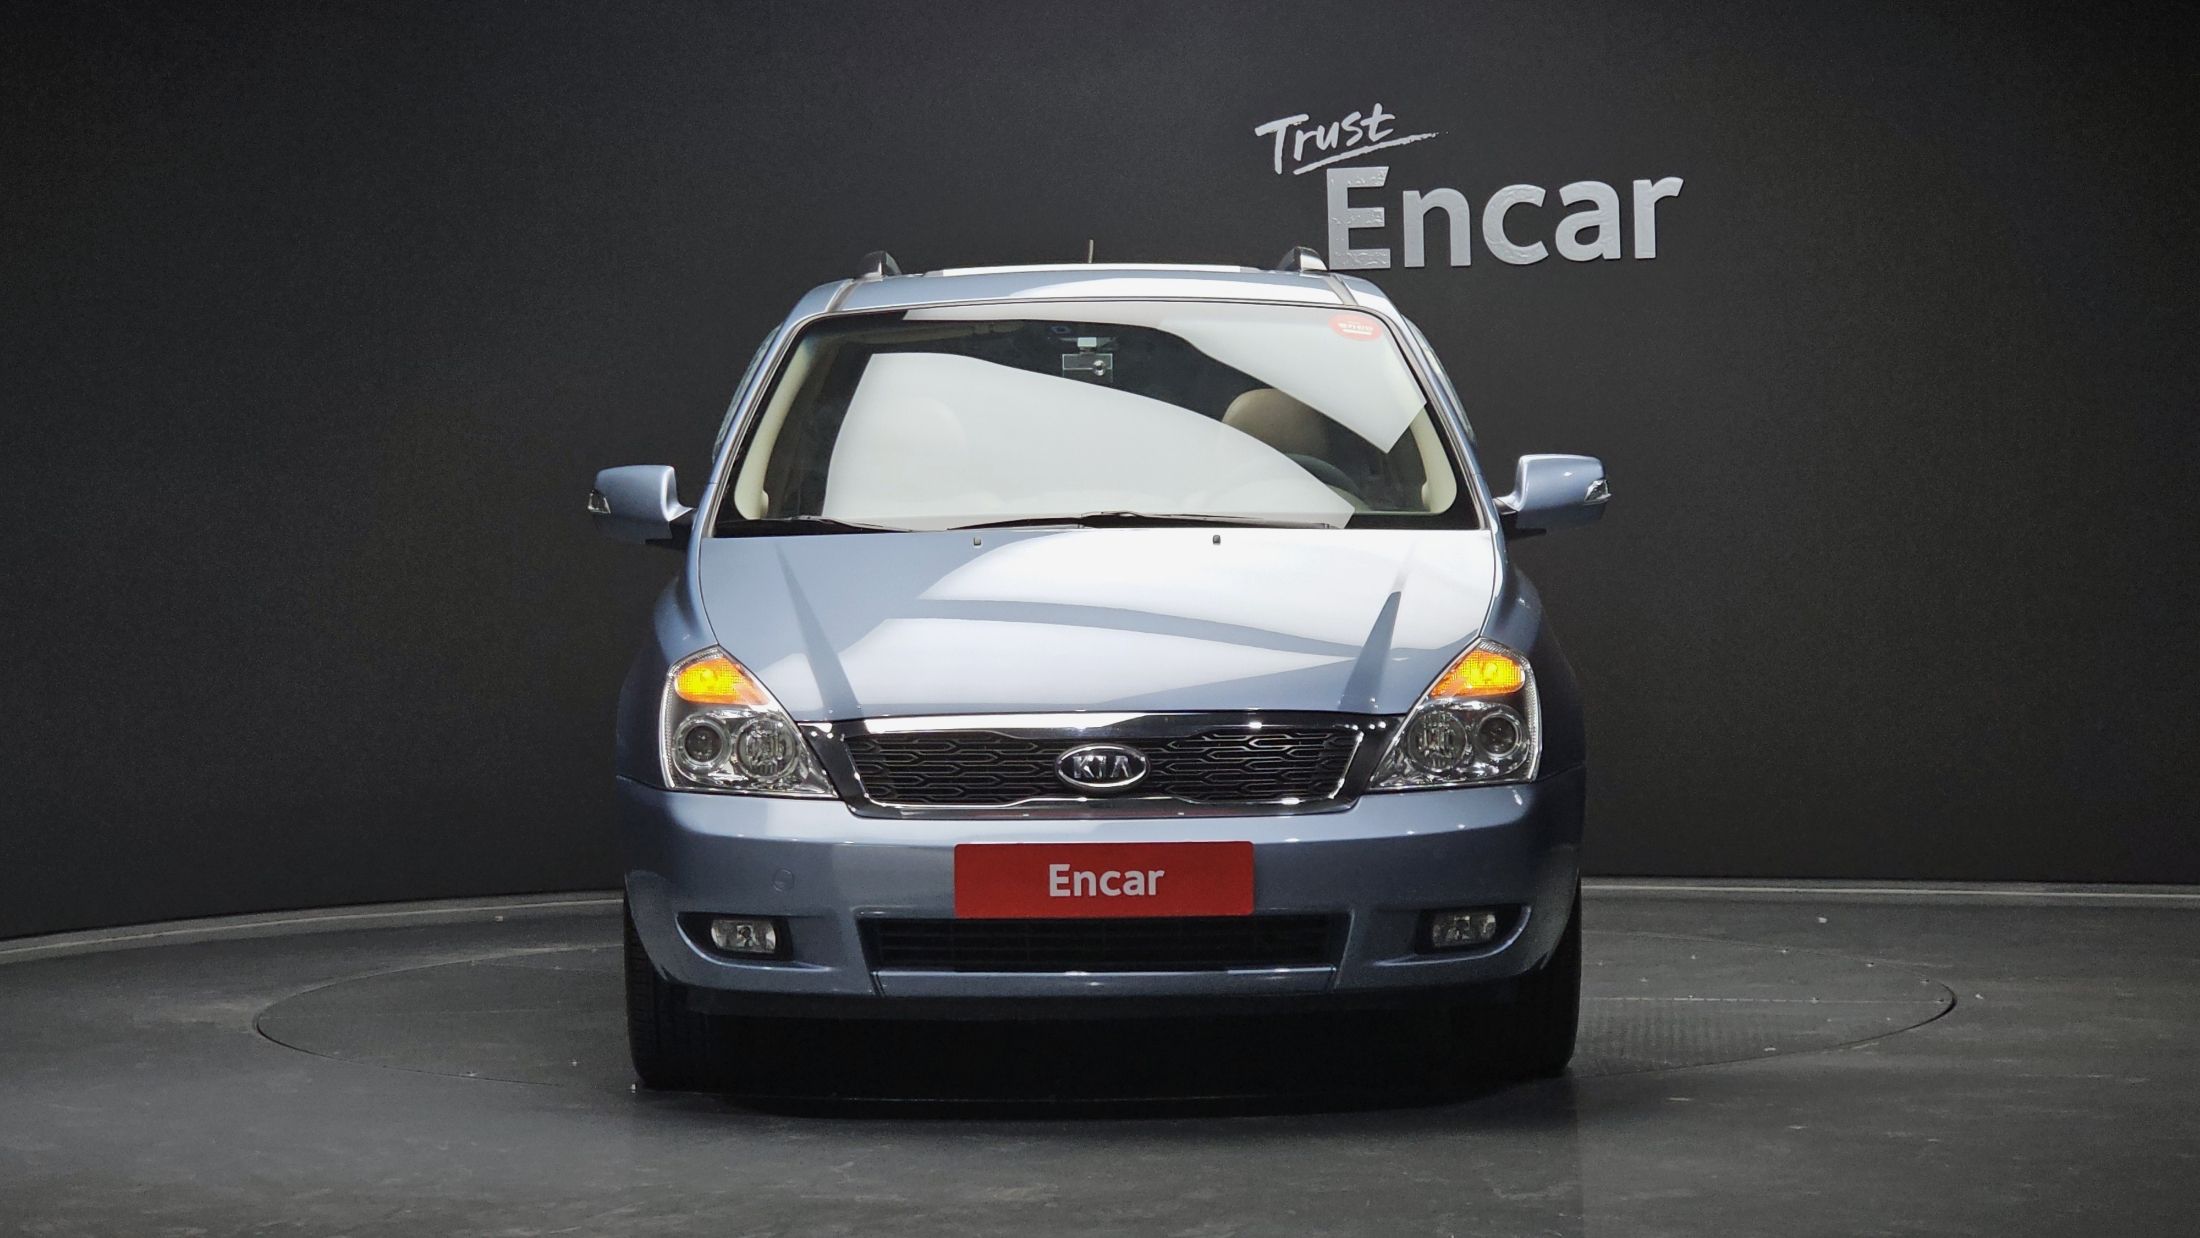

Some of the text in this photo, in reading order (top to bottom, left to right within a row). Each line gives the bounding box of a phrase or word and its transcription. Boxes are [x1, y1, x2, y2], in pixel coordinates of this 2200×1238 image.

[1255, 103, 1395, 174] Trust
[1326, 166, 1684, 269] Encar
[1072, 755, 1132, 778] KIA
[1049, 863, 1165, 897] Encar
